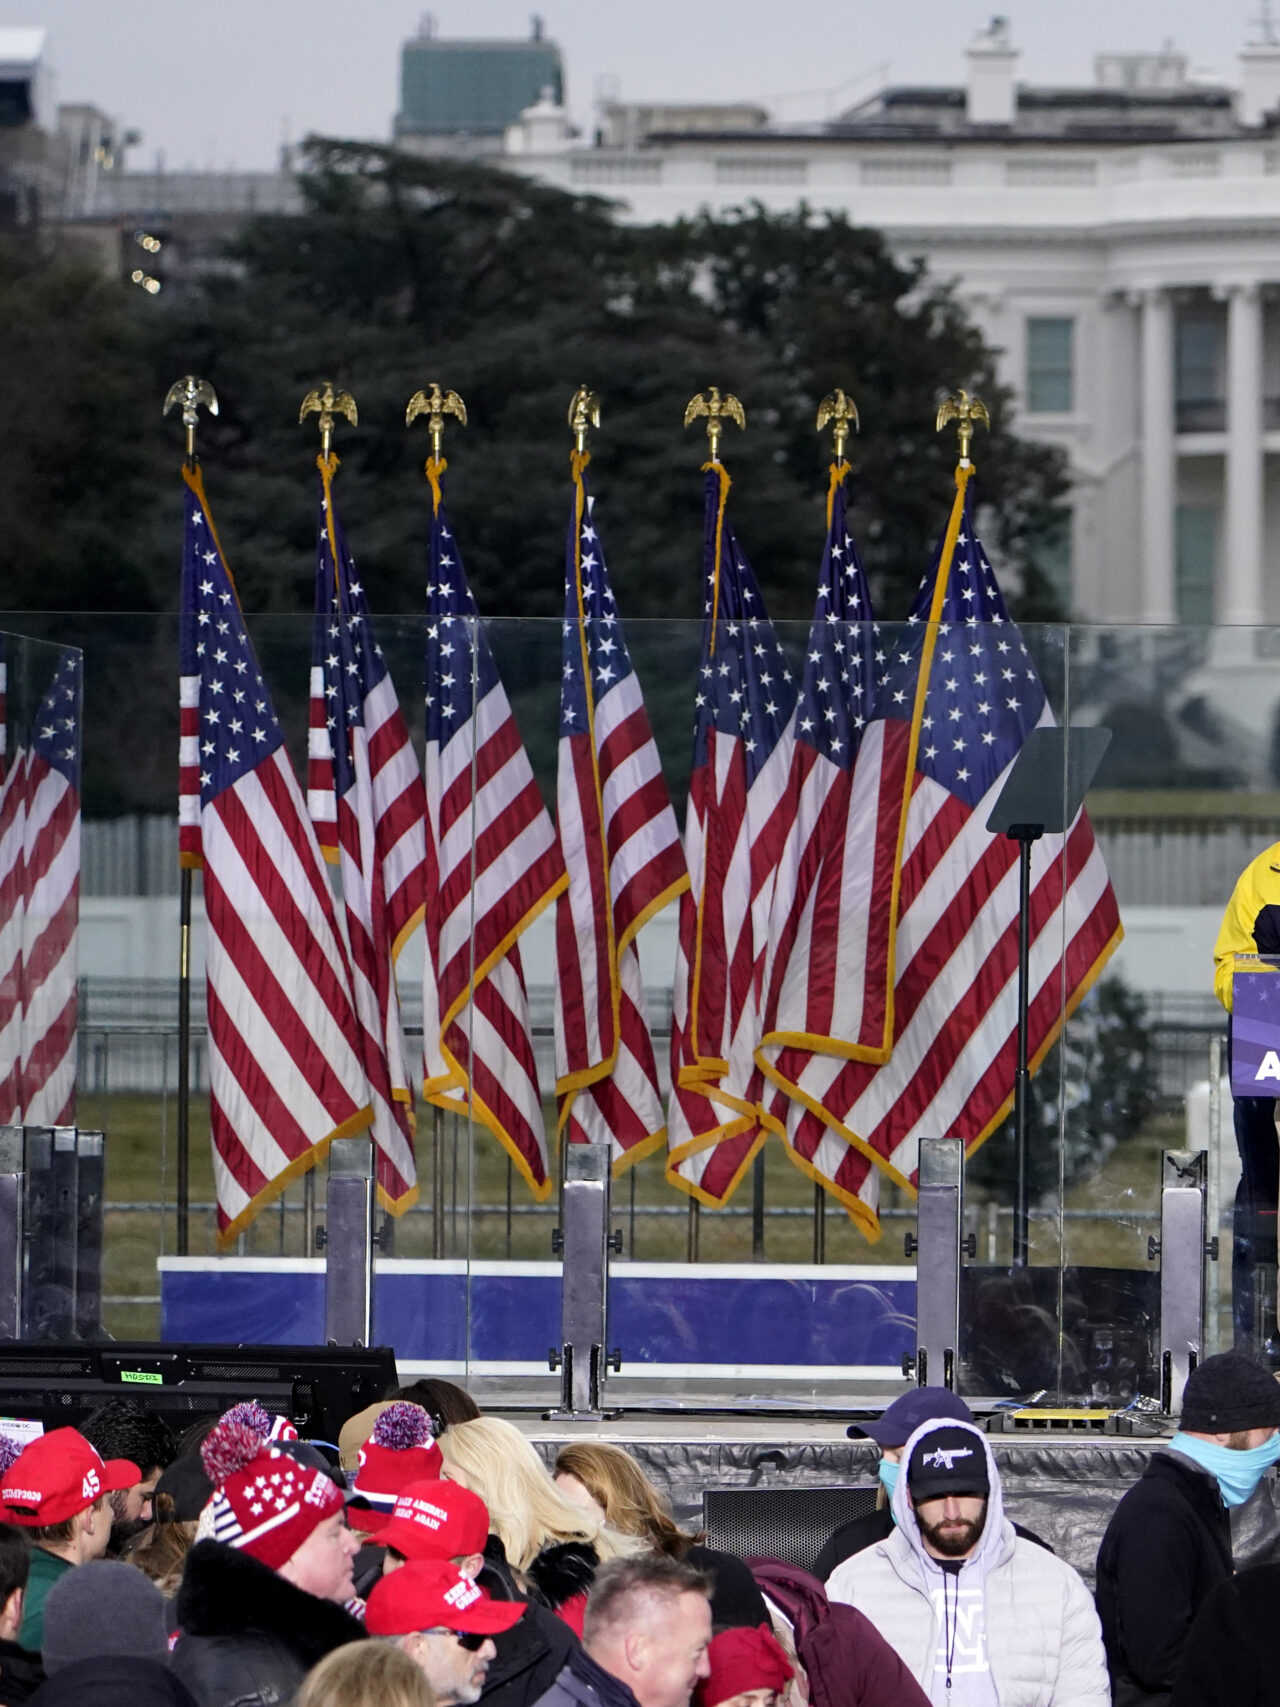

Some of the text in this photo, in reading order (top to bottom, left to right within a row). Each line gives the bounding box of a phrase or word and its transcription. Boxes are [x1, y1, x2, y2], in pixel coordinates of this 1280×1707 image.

[82, 1468, 100, 1498] 45
[412, 1498, 448, 1522] AMERICA
[413, 1512, 440, 1531] AGAIN
